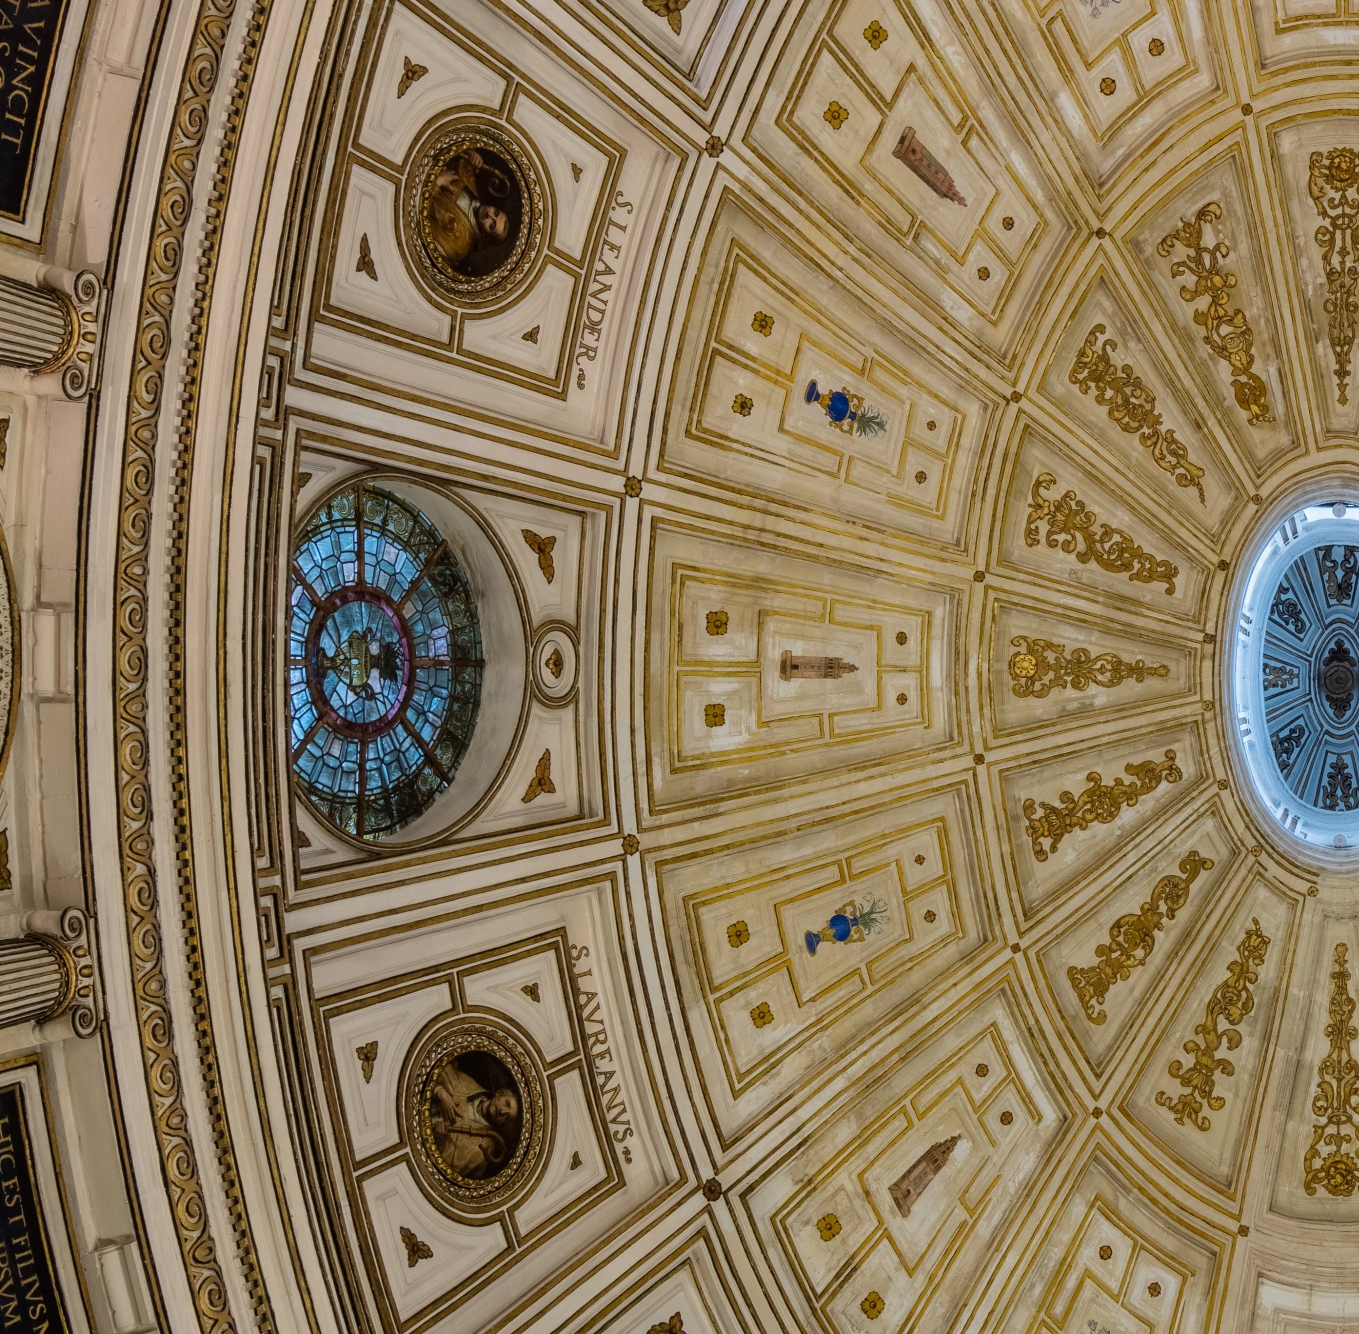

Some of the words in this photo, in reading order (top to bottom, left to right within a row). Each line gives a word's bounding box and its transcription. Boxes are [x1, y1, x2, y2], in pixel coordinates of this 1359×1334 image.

[1, 20, 45, 153] VINCIT
[611, 189, 633, 214] S.
[575, 216, 627, 366] LEANDER
[567, 944, 589, 967] S.
[573, 968, 633, 1143] LAVREANVS
[1, 1177, 26, 1226] EST
[12, 1232, 46, 1319] FILIVS
